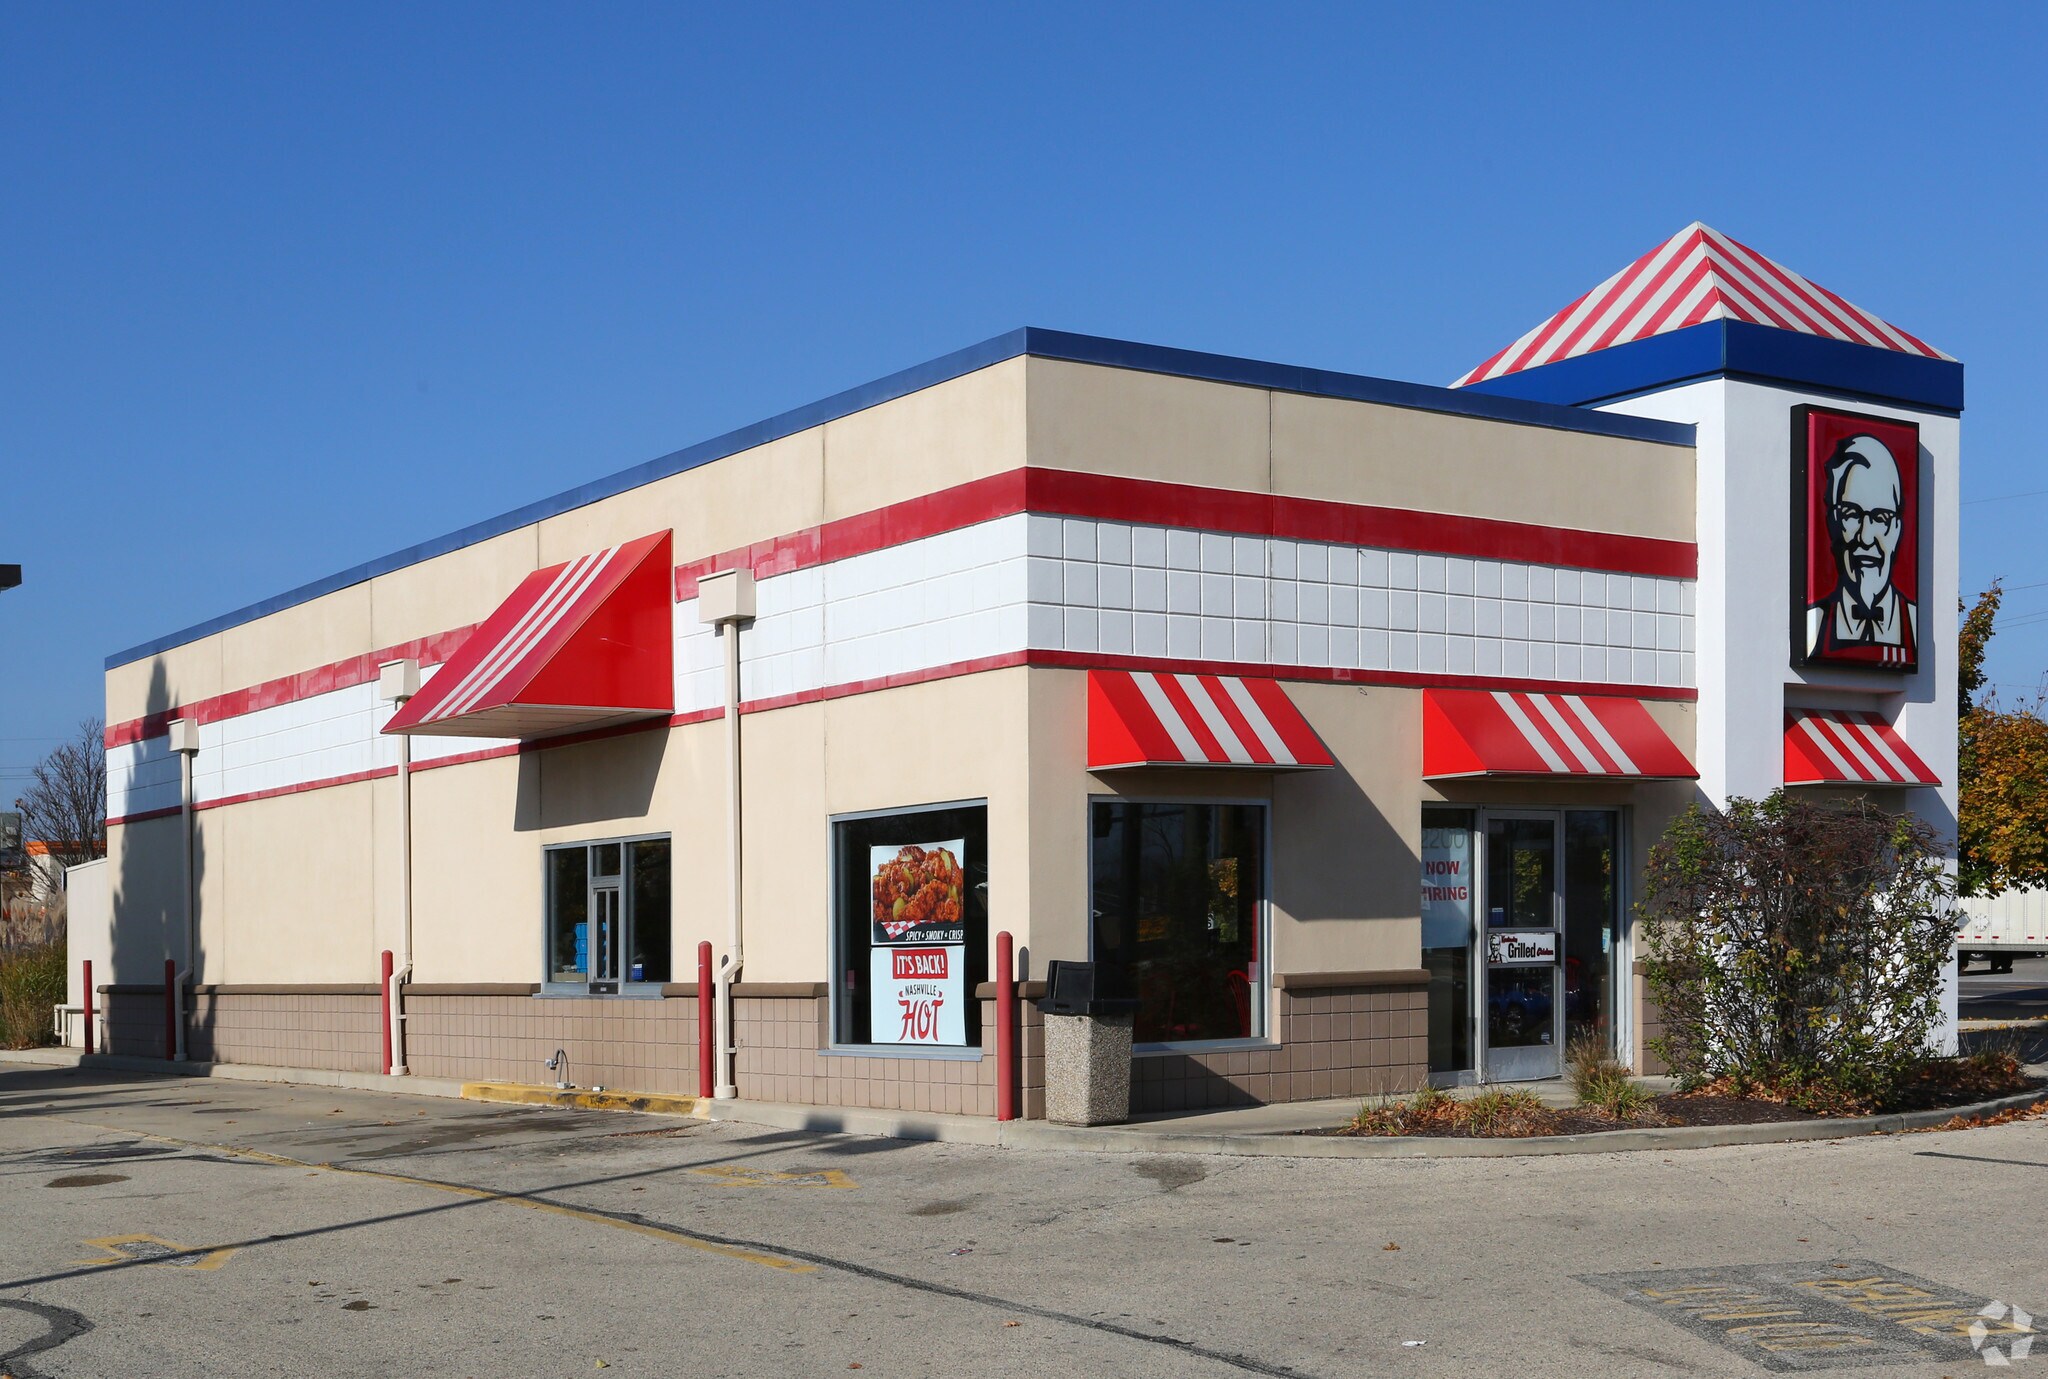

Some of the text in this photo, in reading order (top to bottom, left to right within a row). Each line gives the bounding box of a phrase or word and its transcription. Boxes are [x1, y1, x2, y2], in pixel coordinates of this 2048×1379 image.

[1425, 861, 1460, 875] NOW
[906, 931, 922, 941] SPICY
[925, 930, 944, 940] SMOKY
[1508, 942, 1536, 958] Grilled
[896, 954, 944, 974] IT'S BACK!
[905, 984, 937, 996] NASHVILLE
[898, 999, 944, 1041] HOT
